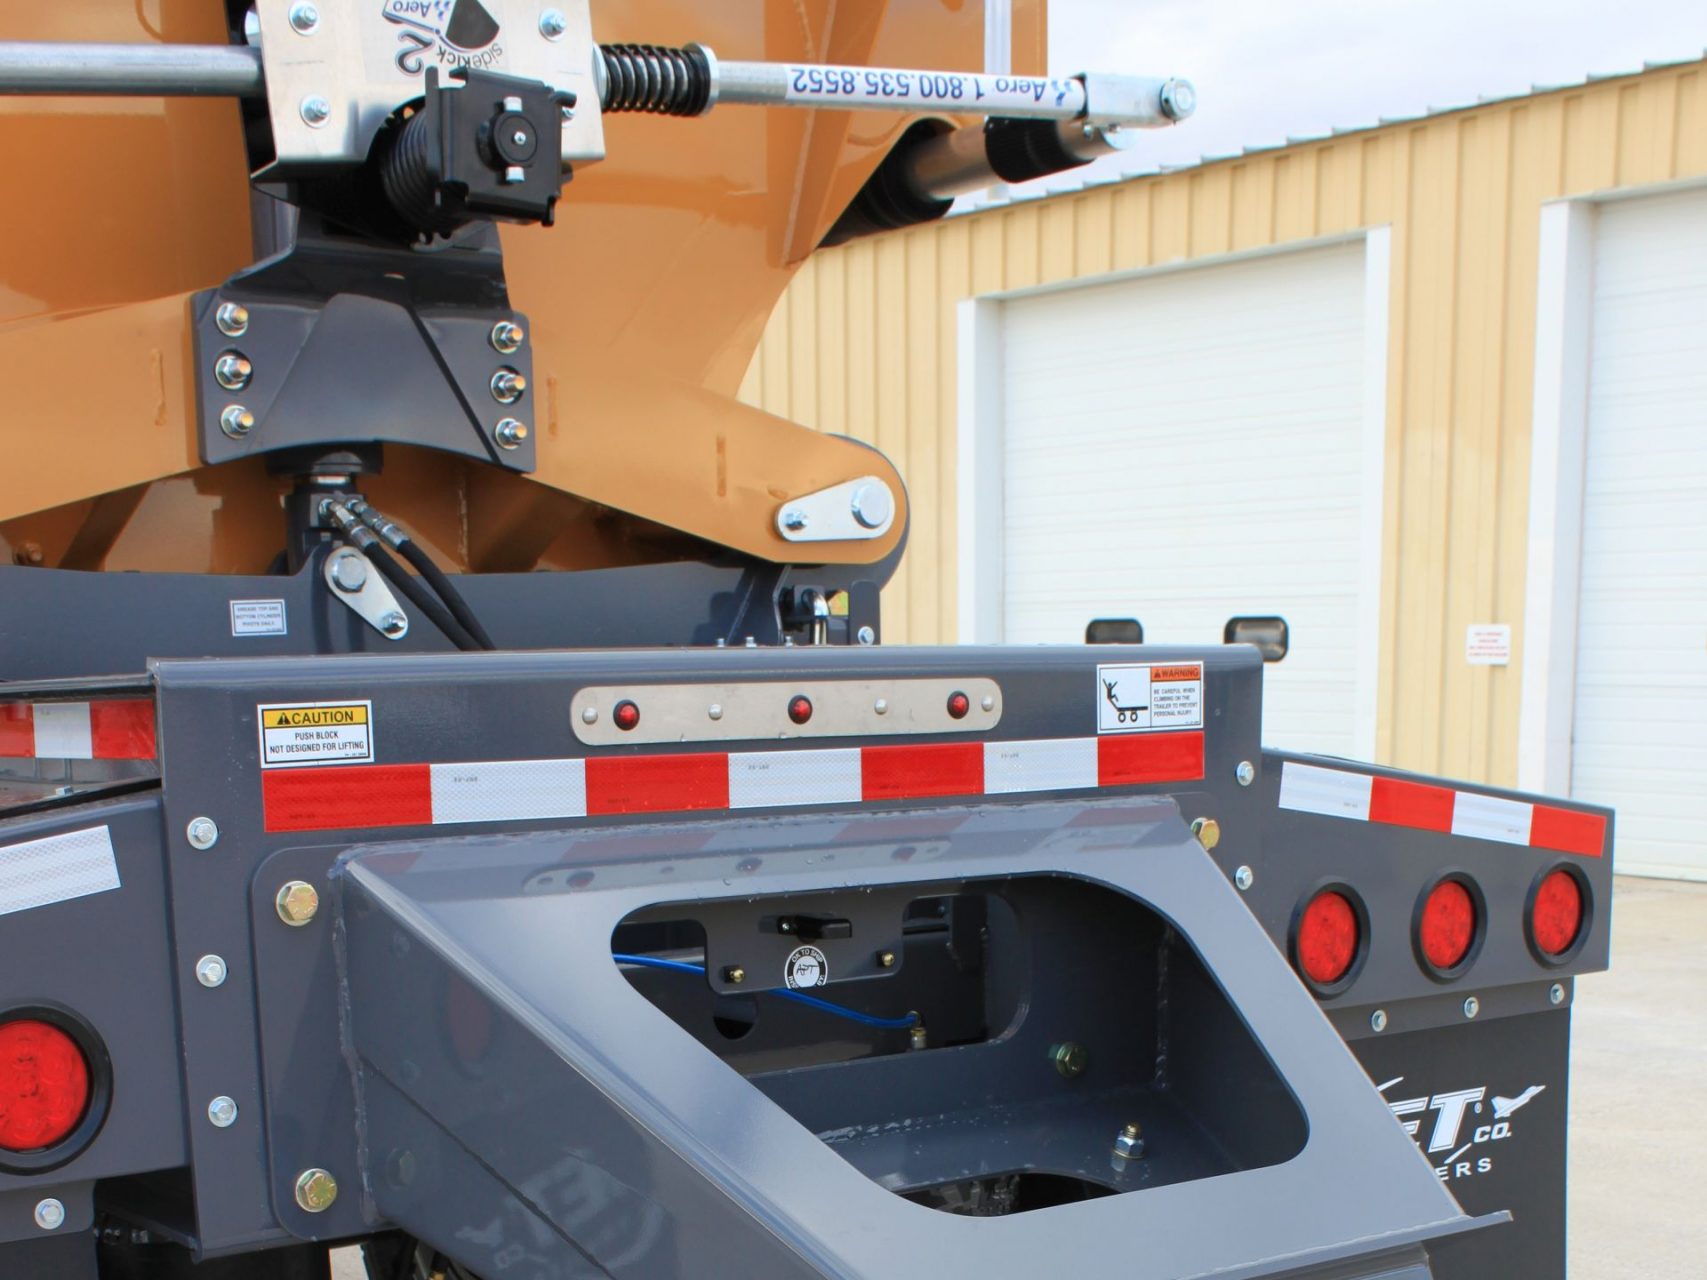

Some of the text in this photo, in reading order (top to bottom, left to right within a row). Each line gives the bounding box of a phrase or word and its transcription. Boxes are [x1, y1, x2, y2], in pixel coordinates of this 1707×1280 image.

[392, 0, 431, 18] Aero
[395, 29, 436, 77] 2
[995, 77, 1047, 102] Aero
[1161, 668, 1199, 679] WARNING
[291, 710, 354, 725] CAUTION
[295, 731, 339, 741] PUSH BLOCK
[270, 741, 365, 754] NOT DESIGNED FOR LIFTING
[801, 948, 810, 956] TO
